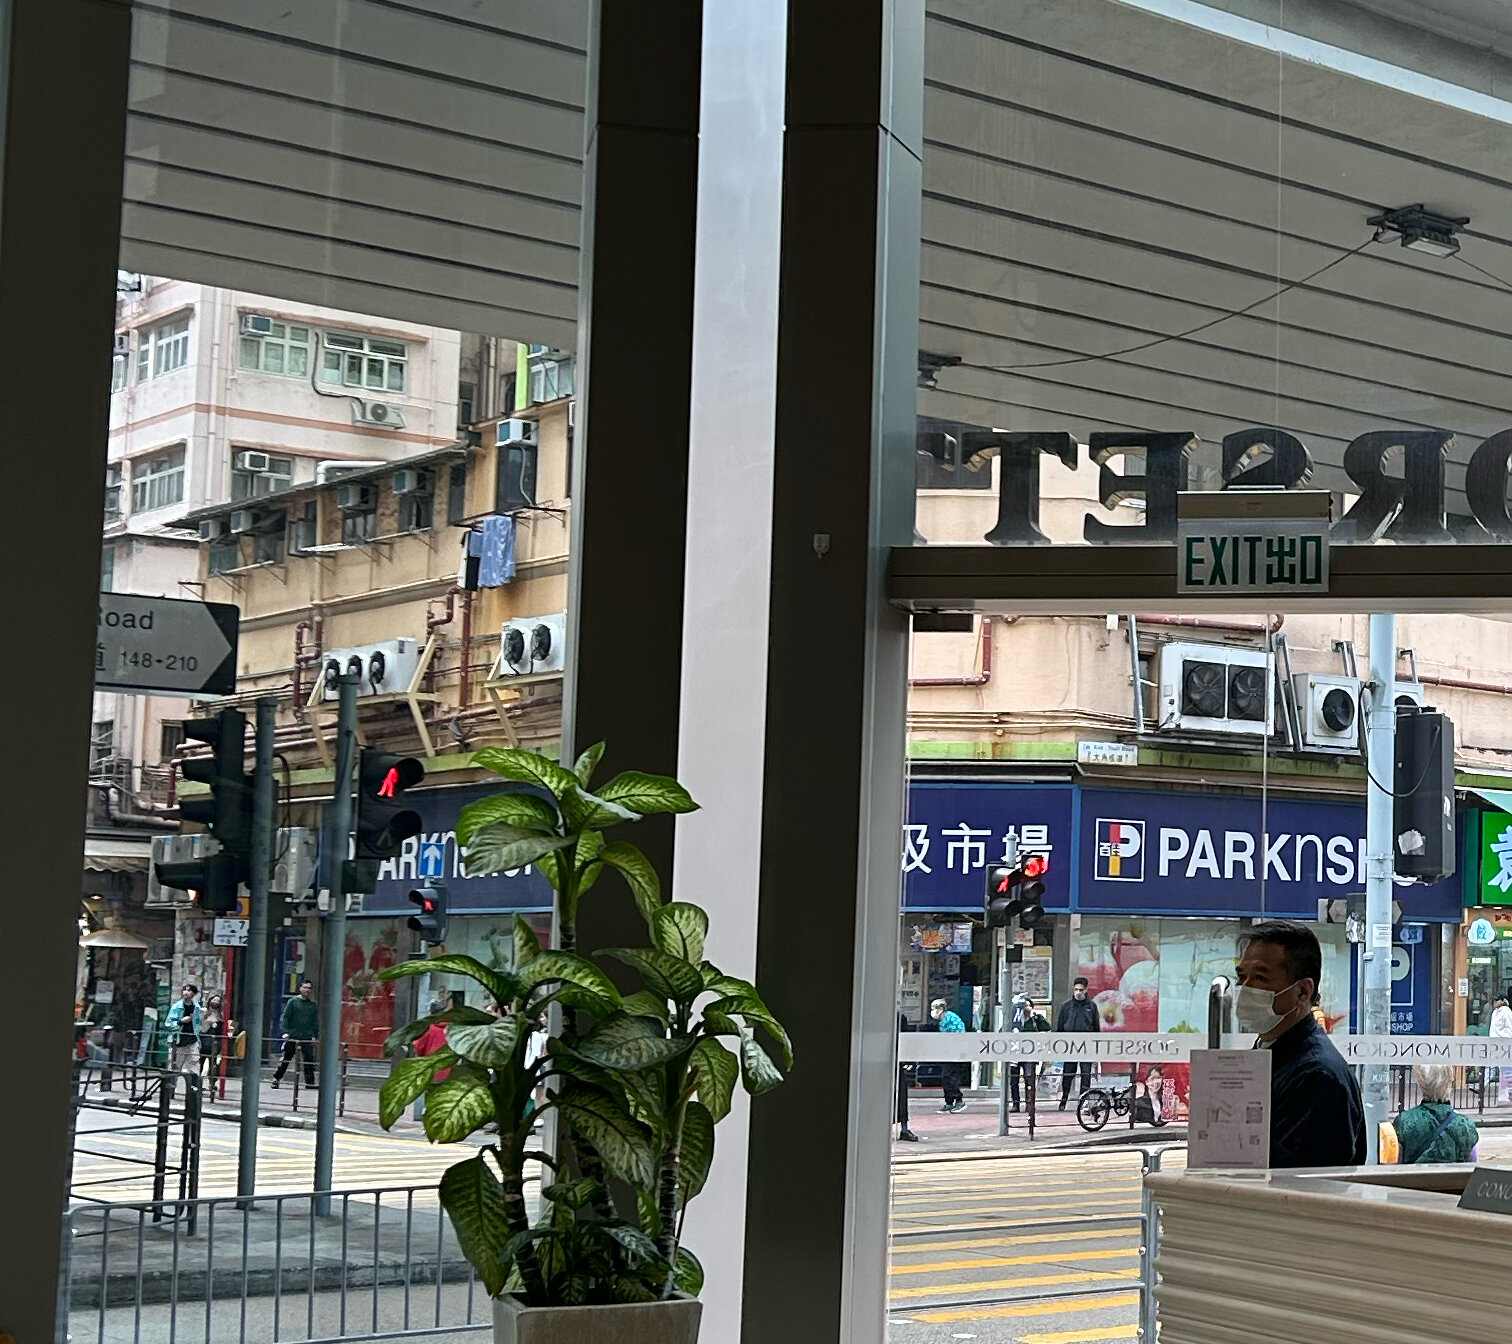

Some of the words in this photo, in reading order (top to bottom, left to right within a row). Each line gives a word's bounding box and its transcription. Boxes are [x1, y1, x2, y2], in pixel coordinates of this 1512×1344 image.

[1184, 535, 1263, 587] EXIT
[1264, 535, 1323, 587] 出口
[98, 606, 154, 631] oad
[121, 650, 198, 672] 148-210
[1158, 826, 1420, 887] PARKnS
[1391, 1022, 1414, 1033] SHOP
